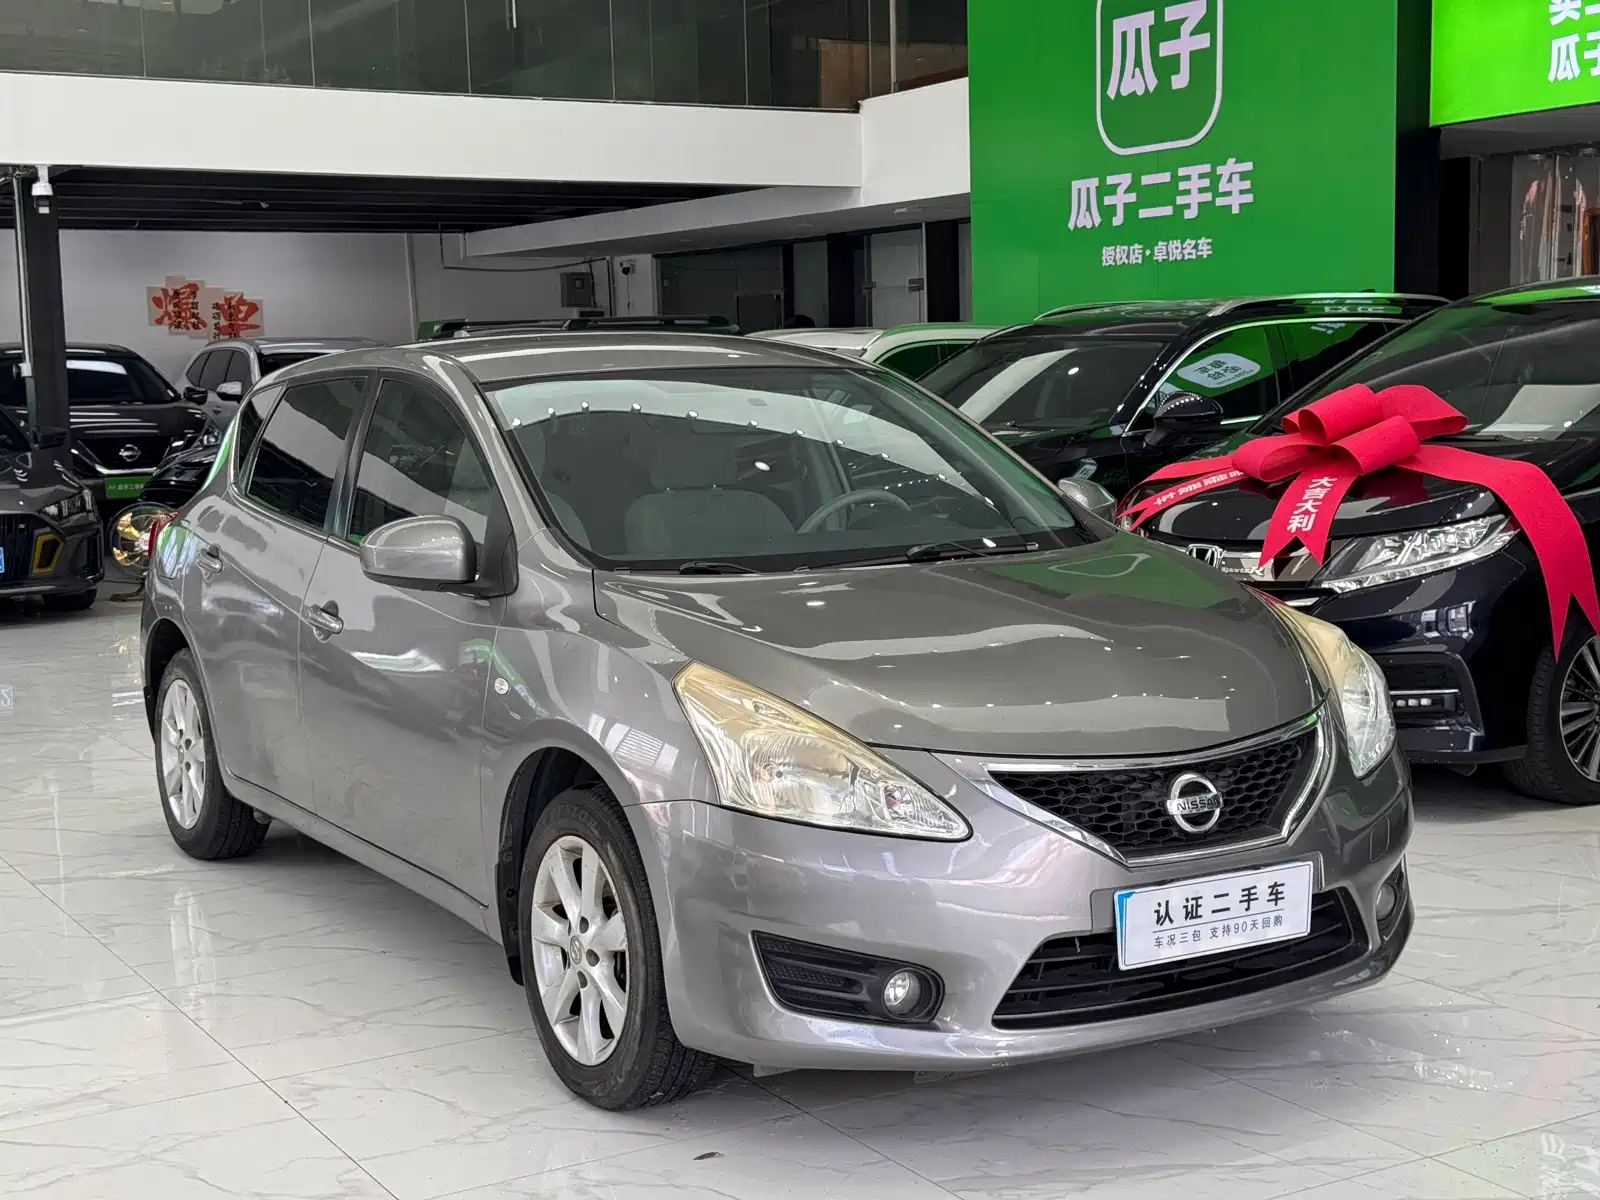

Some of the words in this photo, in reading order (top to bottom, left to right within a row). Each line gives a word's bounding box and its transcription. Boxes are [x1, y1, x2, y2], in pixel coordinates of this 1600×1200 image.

[1107, 0, 1211, 100] 瓜子
[1068, 158, 1254, 231] 瓜子二手车
[1102, 237, 1213, 267] 授权店·卓悦名车
[1287, 477, 1338, 533] 大吉大利
[1176, 796, 1222, 812] NISSAN
[1154, 881, 1286, 926] 认证二手车
[1153, 929, 1202, 949] 车况三包
[1209, 913, 1284, 940] 支持90天回购
